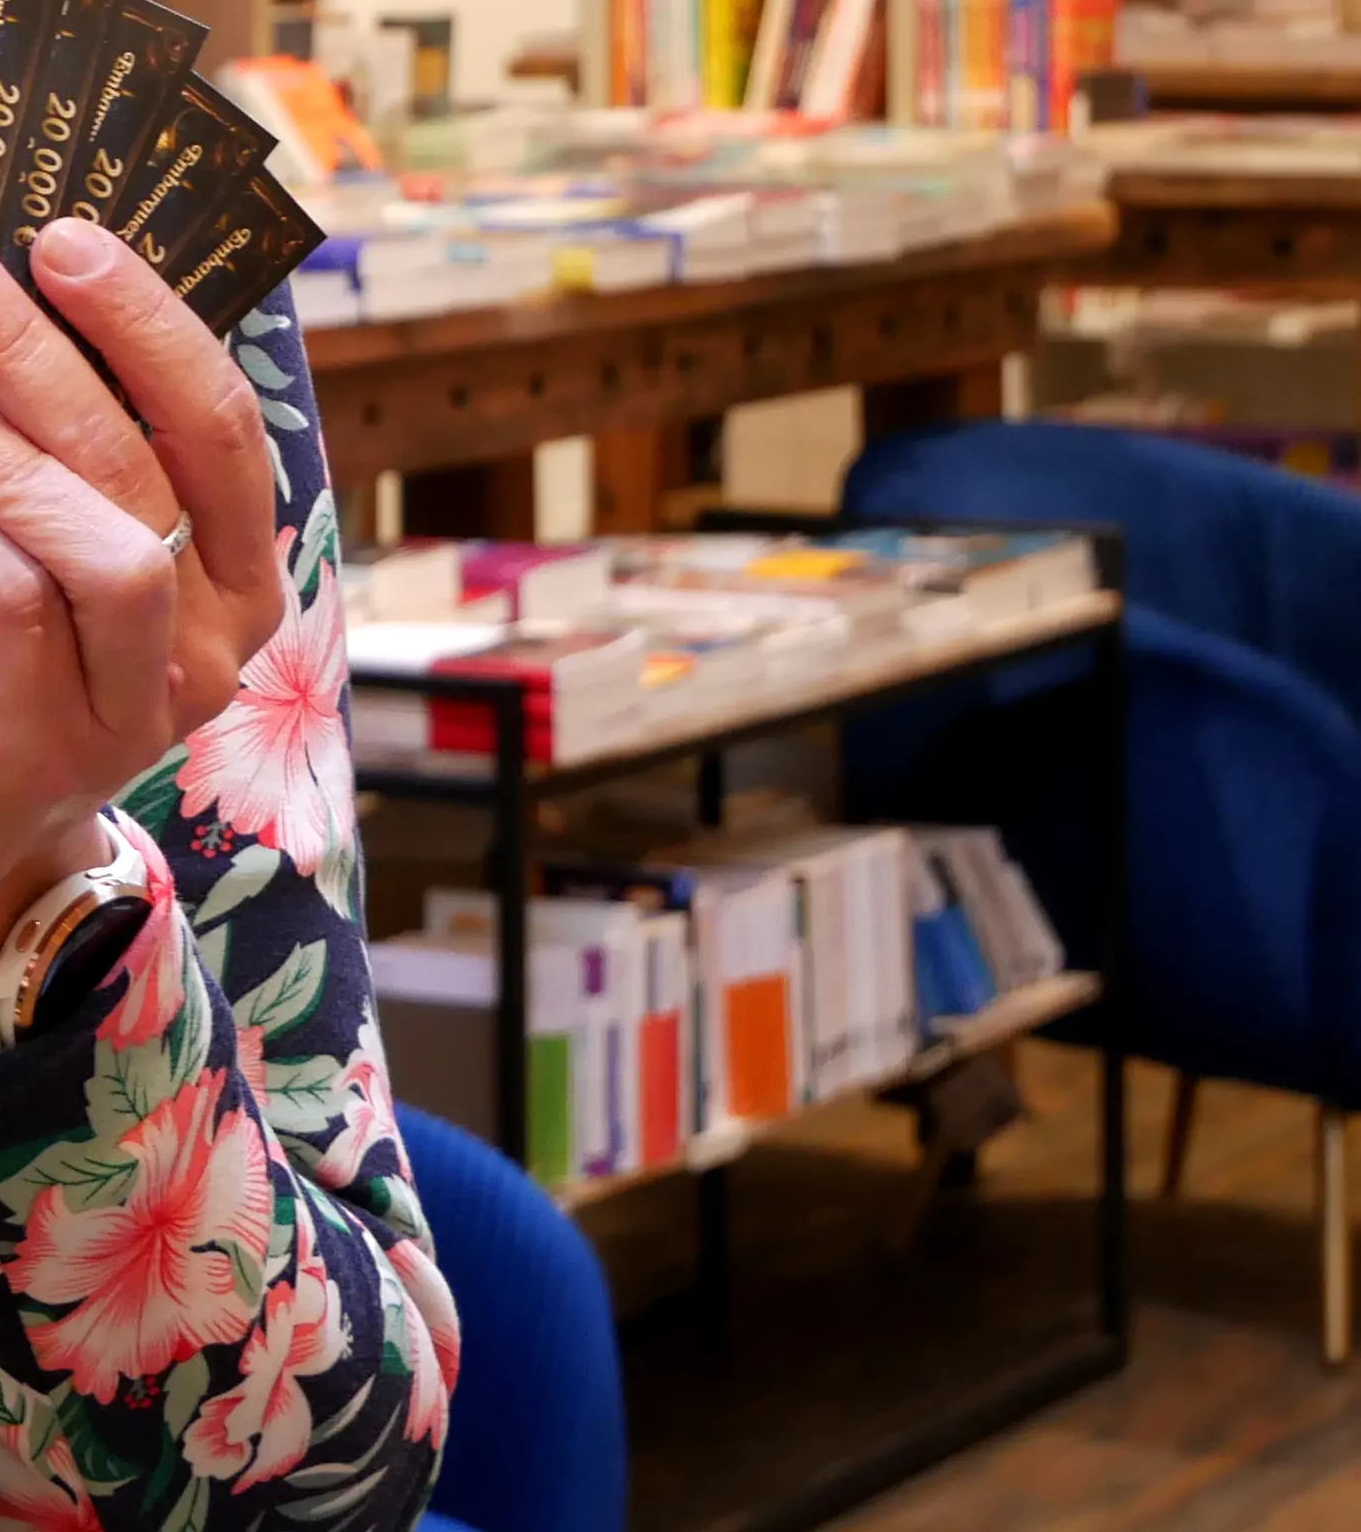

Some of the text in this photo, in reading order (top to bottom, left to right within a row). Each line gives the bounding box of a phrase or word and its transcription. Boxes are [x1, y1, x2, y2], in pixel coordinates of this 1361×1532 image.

[41, 92, 77, 142] 20
[21, 148, 63, 218] 000
[85, 148, 123, 198] 20
[175, 228, 252, 299] Embarqu
